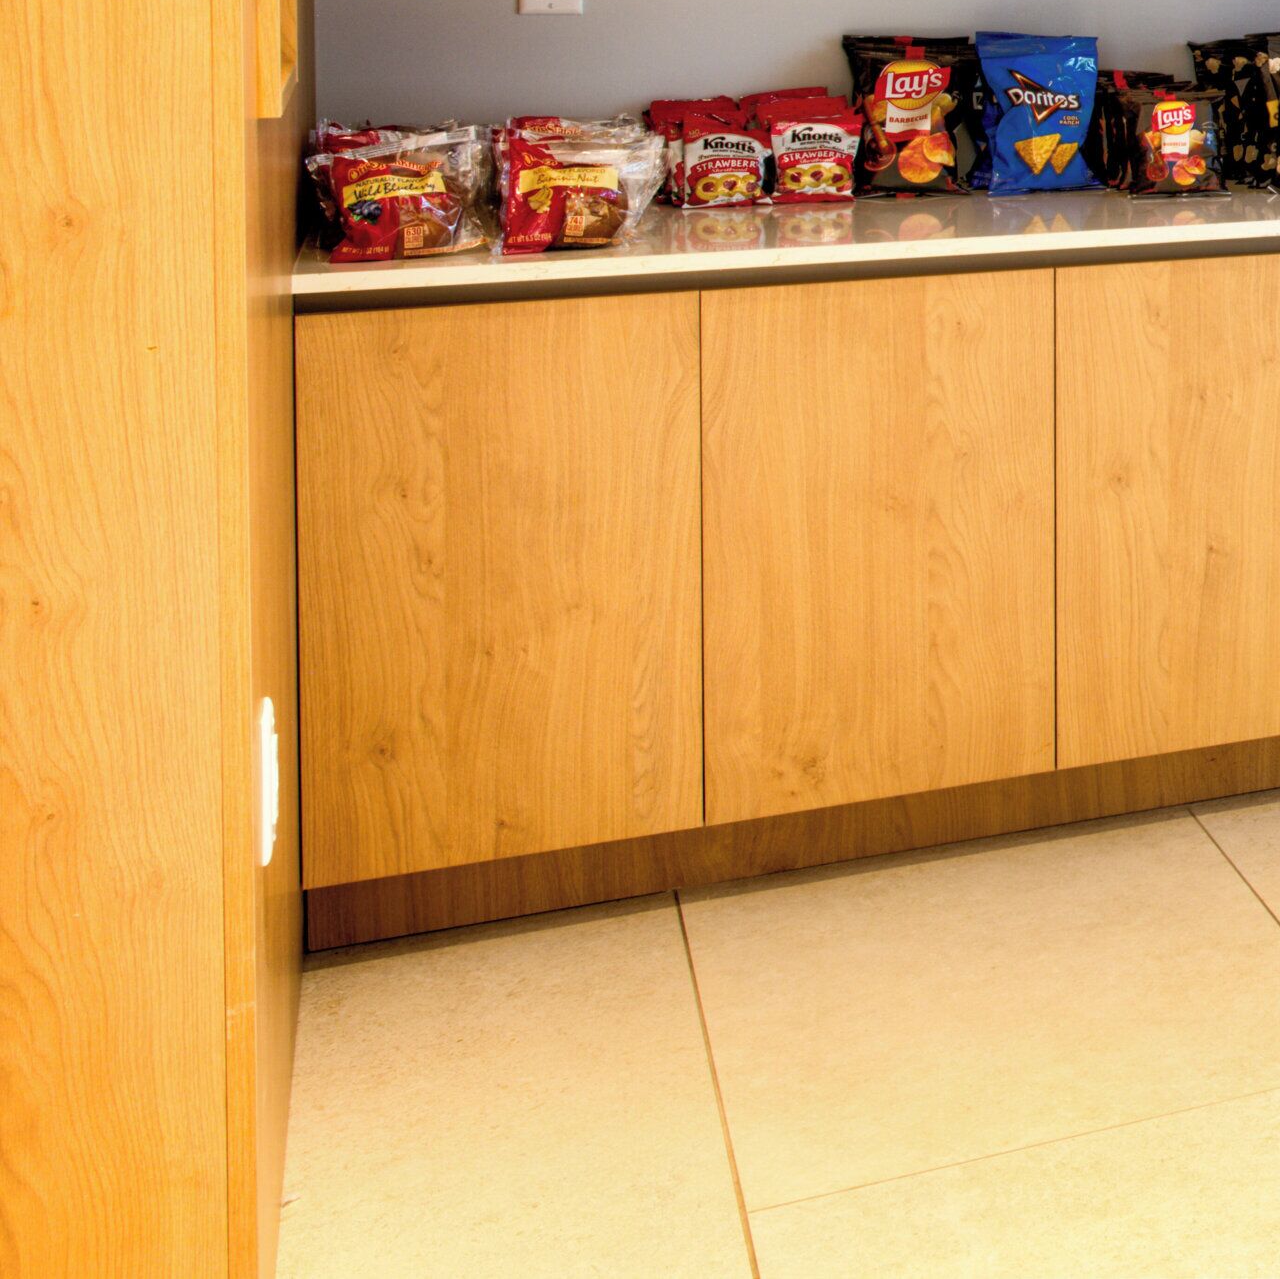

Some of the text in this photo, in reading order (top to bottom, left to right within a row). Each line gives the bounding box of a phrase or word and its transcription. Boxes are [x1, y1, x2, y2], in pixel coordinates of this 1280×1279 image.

[885, 68, 942, 99] Lay's
[1007, 88, 1079, 109] Doritos
[889, 114, 928, 123] BARBECUE
[1157, 107, 1192, 130] Lay's
[791, 127, 842, 143] Knott's
[703, 136, 756, 154] Knott's
[783, 151, 847, 162] STRAWBERRY
[577, 174, 599, 183] Nut
[353, 183, 436, 200] Wild Blueberry
[569, 216, 583, 225] 740
[406, 226, 422, 236] 630
